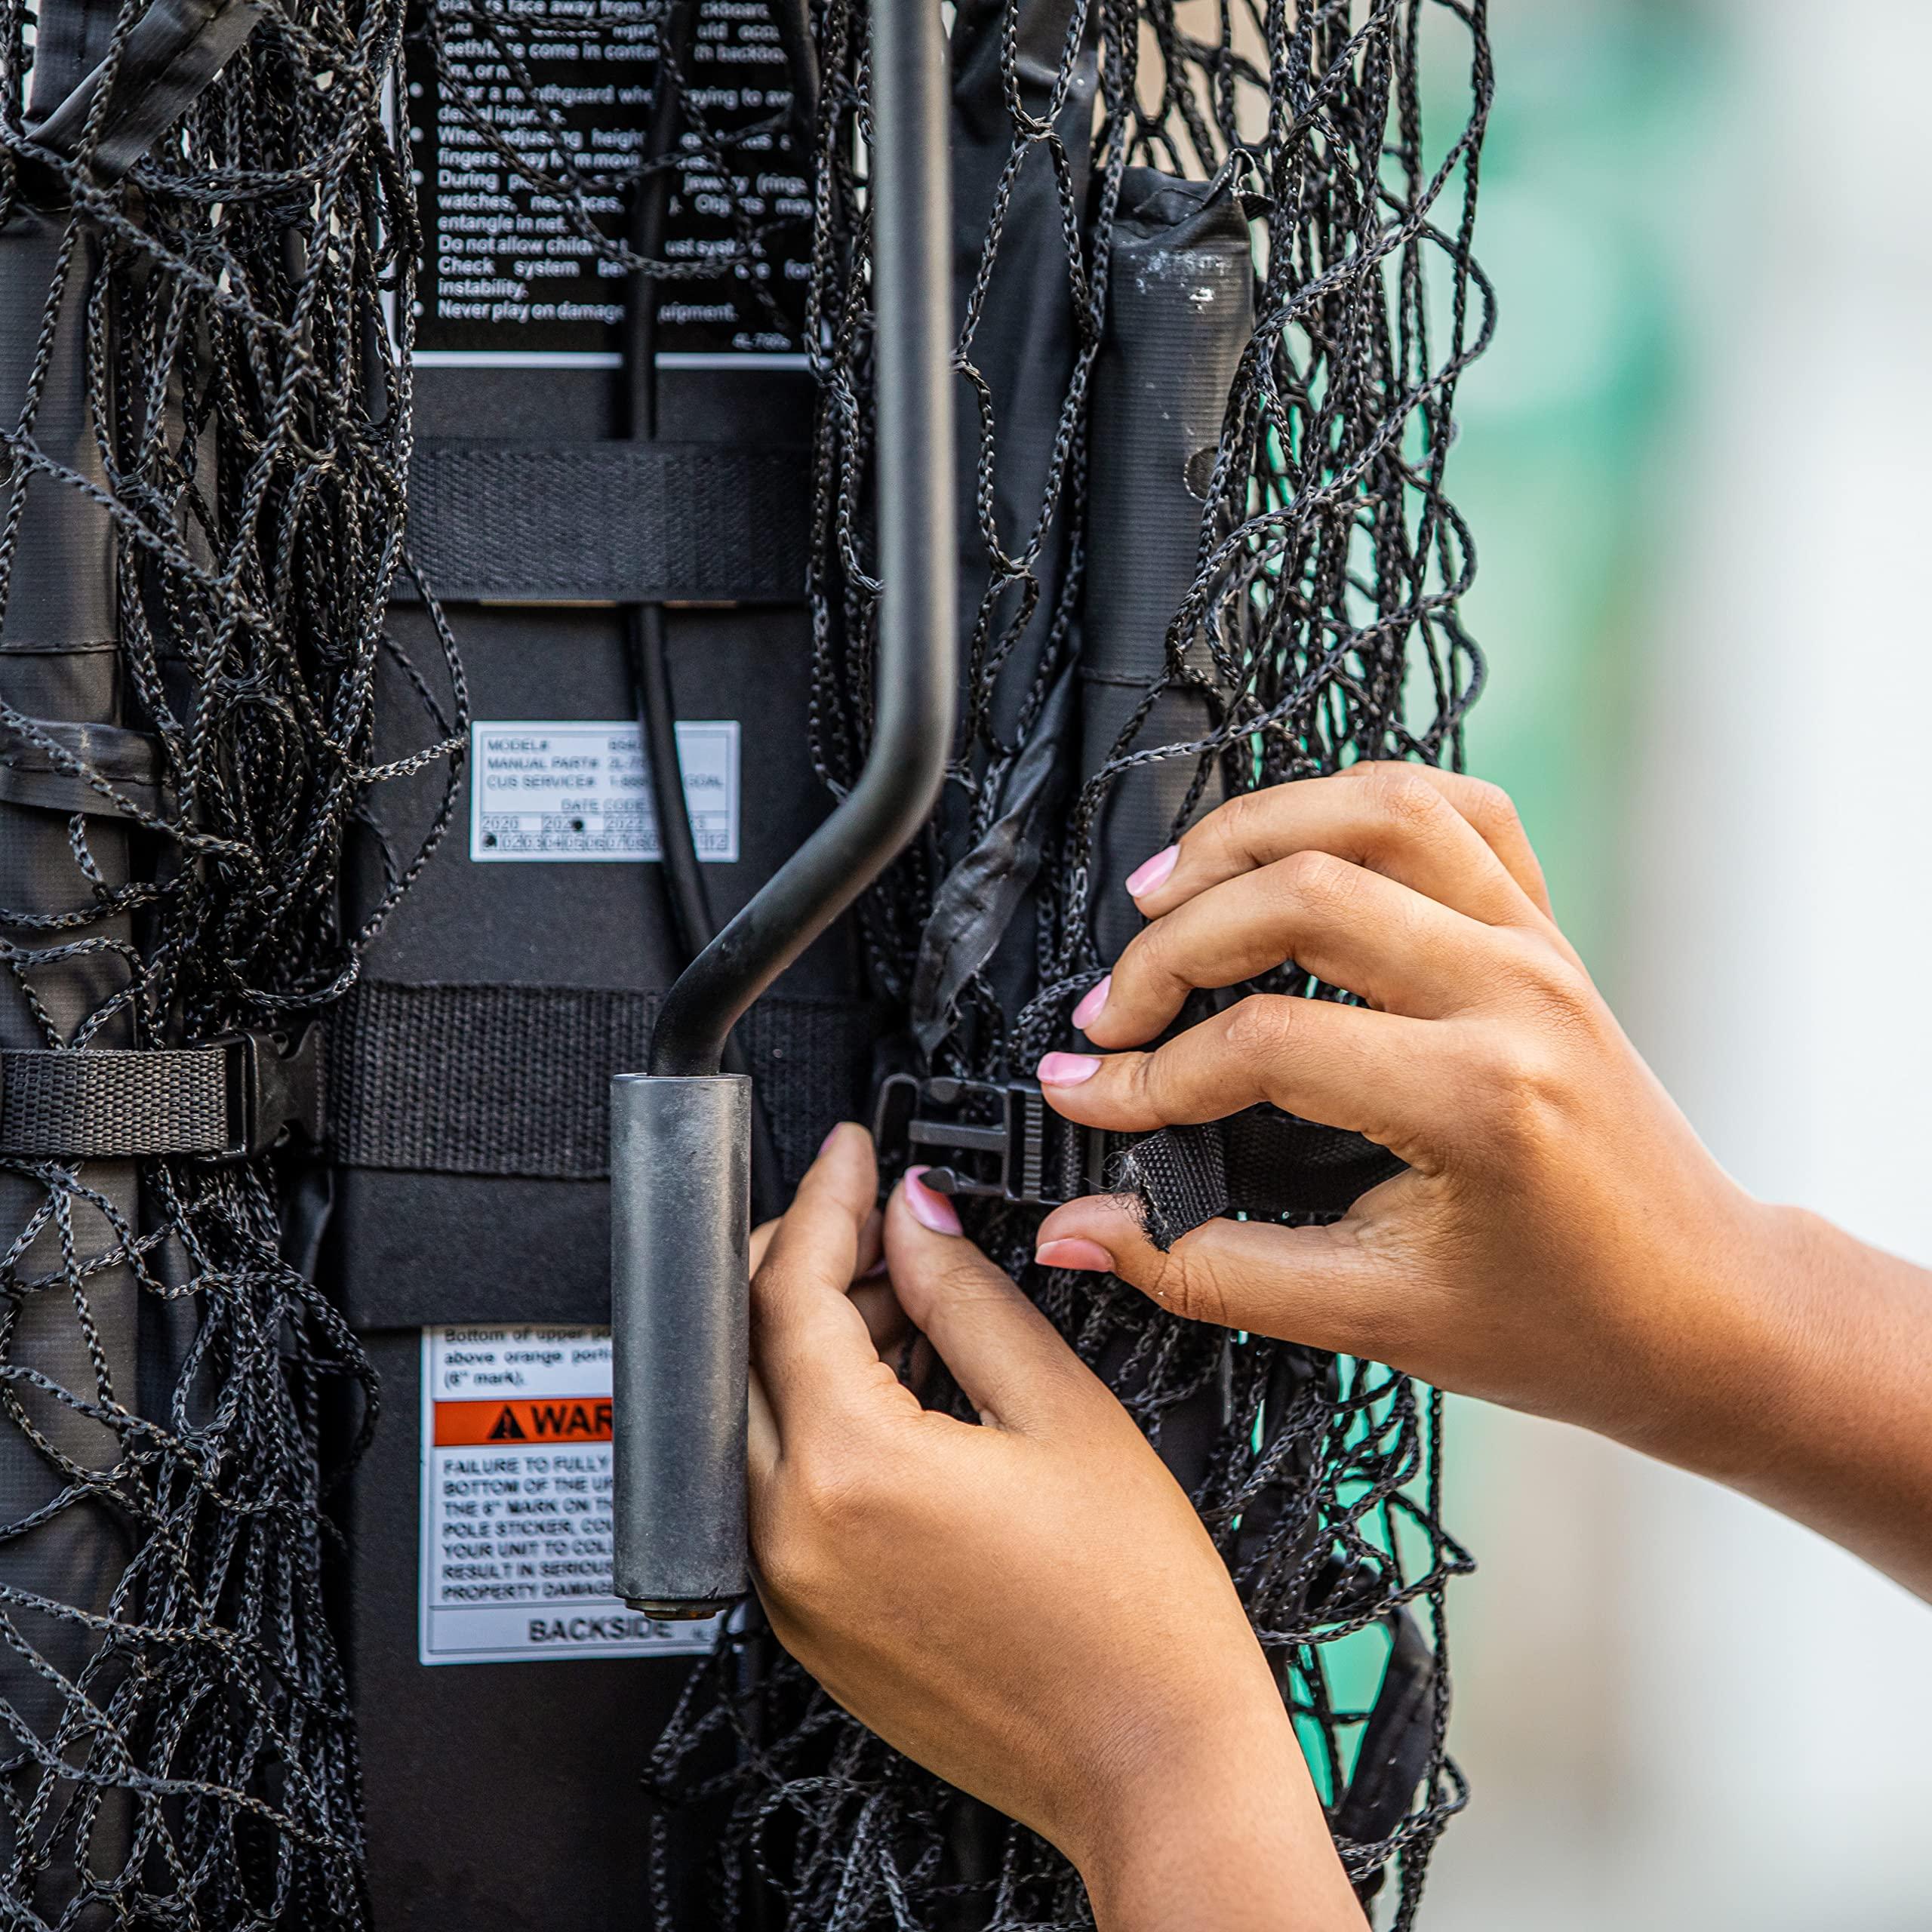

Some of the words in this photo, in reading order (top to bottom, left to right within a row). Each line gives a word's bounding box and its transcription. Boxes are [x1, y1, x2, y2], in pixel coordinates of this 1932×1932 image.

[508, 0, 546, 14] face
[550, 0, 597, 17] away
[529, 42, 580, 60] come
[582, 41, 602, 60] in
[474, 64, 495, 81] or
[488, 86, 503, 102] a
[741, 88, 763, 106] to
[437, 147, 502, 170] fingers
[437, 169, 500, 192] During
[437, 192, 518, 214] watches,
[437, 214, 515, 234] entangle
[515, 214, 534, 232] in
[535, 215, 571, 232] net.
[437, 234, 465, 254] Do
[466, 237, 496, 255] not
[497, 236, 545, 255] allow
[437, 256, 496, 276] Check
[513, 259, 581, 280] system
[437, 278, 529, 302] instability.
[437, 300, 490, 319] Never
[491, 300, 529, 323] play
[531, 303, 555, 321] on
[488, 756, 547, 770] MANUAL
[561, 798, 598, 812] DATE
[604, 798, 648, 812] CODE
[444, 1327, 506, 1343] Bottom
[512, 1327, 531, 1343] of
[537, 1328, 584, 1346] upper
[445, 1351, 495, 1366] above
[503, 1349, 564, 1368] orange
[443, 1457, 520, 1475] FAILURE
[525, 1457, 549, 1472] TO
[553, 1454, 609, 1472] FULLY
[443, 1478, 520, 1497] BOTTOM
[524, 1477, 549, 1494] OF
[554, 1476, 589, 1492] THE
[441, 1500, 478, 1517] THE
[506, 1497, 558, 1515] MARK
[564, 1497, 591, 1513] ON
[442, 1521, 491, 1539] POLE
[441, 1542, 494, 1560] YOUR
[498, 1540, 540, 1558] UNIT
[544, 1539, 568, 1557] TO
[442, 1563, 513, 1581] RESULT
[517, 1561, 537, 1579] IN
[442, 1583, 540, 1601] PROPERTY
[529, 1616, 674, 1642] BACKSIDE
